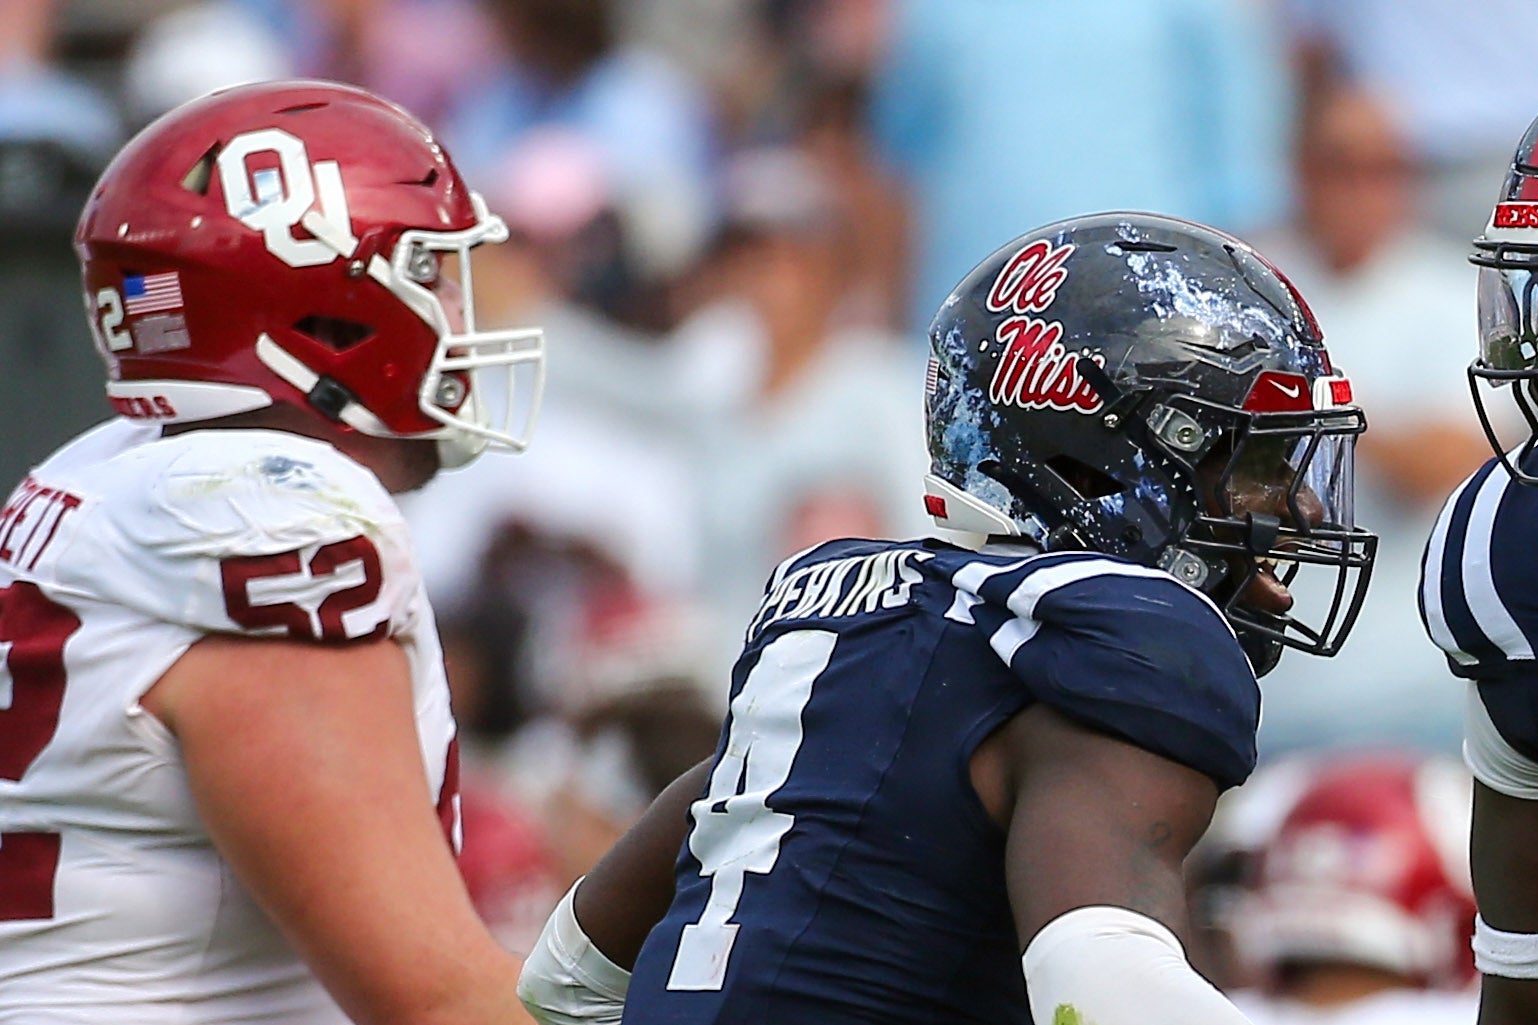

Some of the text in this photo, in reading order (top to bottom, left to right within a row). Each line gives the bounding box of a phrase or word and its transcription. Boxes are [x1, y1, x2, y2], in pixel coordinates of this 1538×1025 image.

[217, 127, 359, 267] OU
[986, 240, 1075, 315] Ole
[220, 535, 390, 642] 52
[748, 549, 936, 643] PERKINS
[666, 629, 839, 991] 4
